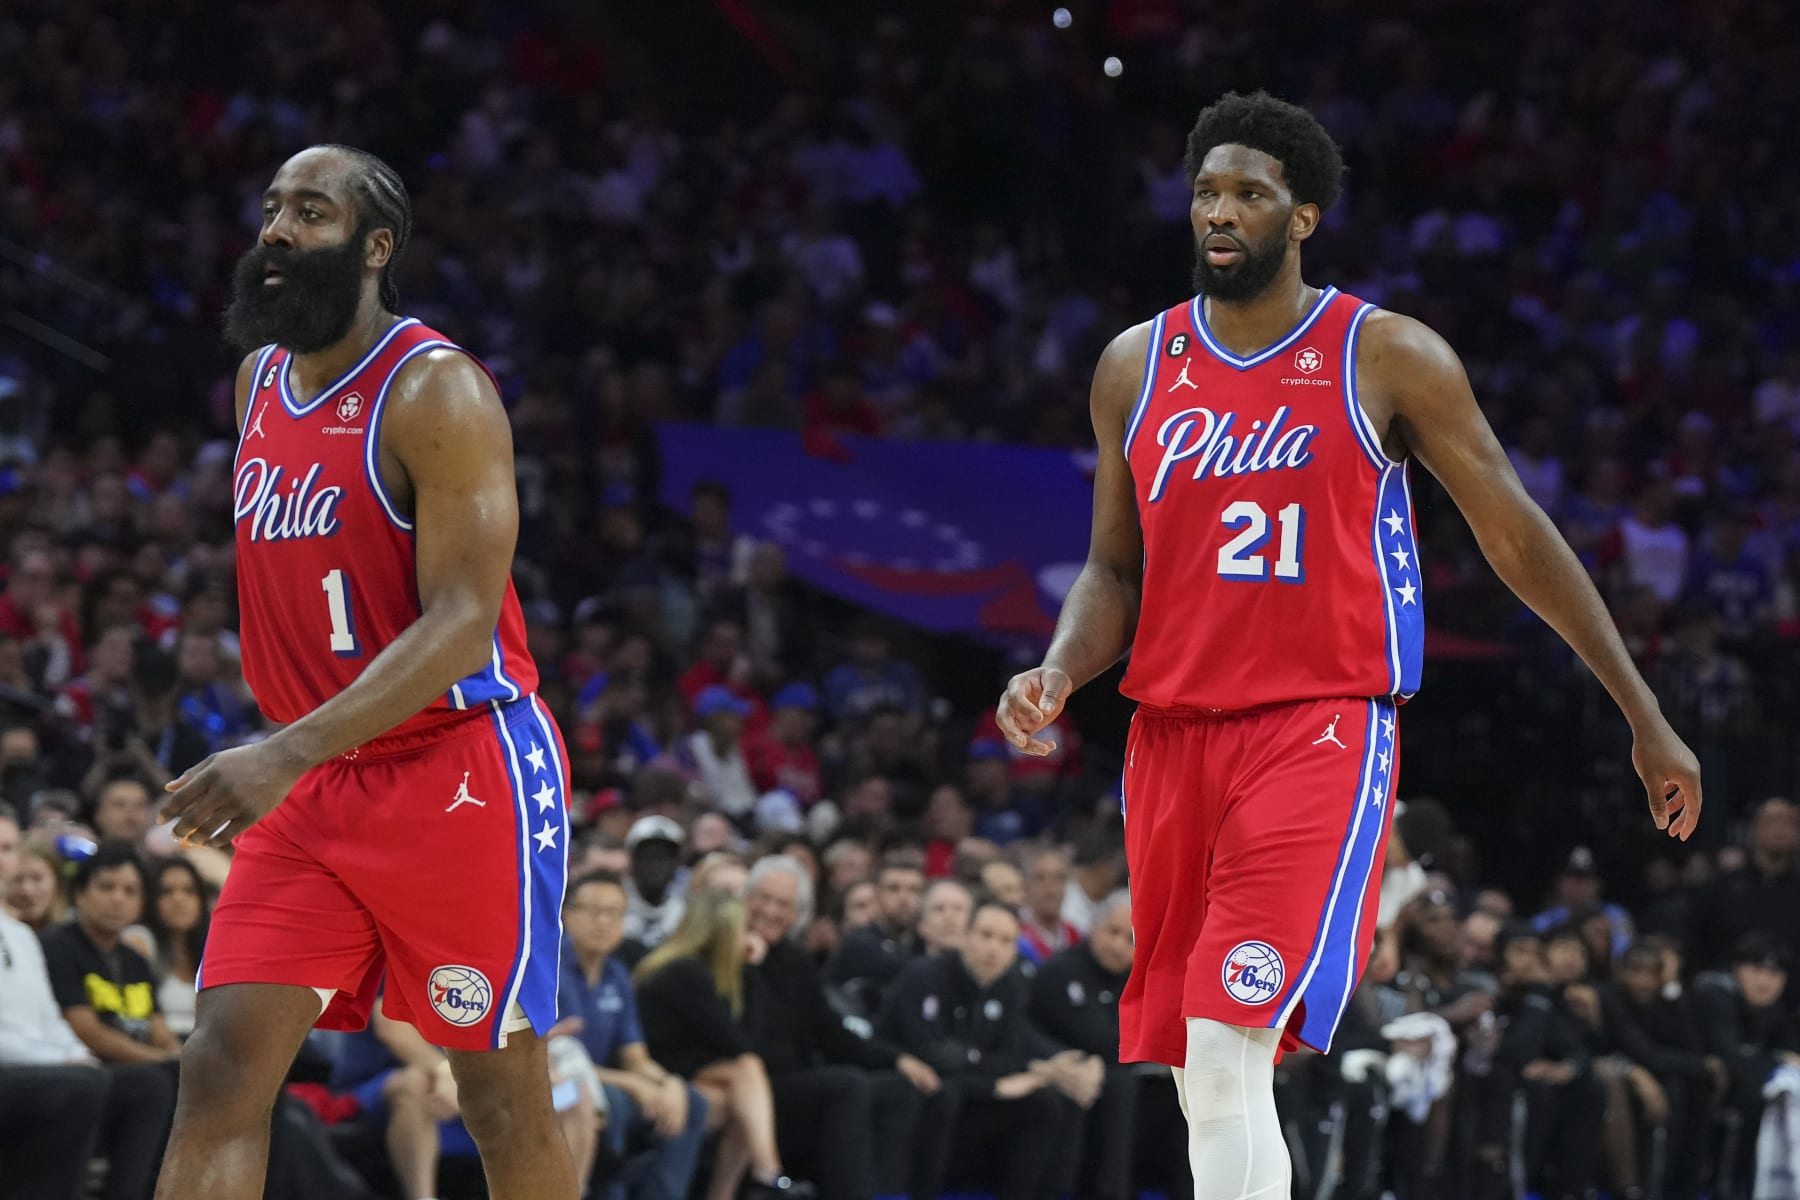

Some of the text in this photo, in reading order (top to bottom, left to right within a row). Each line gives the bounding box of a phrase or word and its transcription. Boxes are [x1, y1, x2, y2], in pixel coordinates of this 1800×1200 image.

[1171, 336, 1185, 355] 6
[263, 365, 278, 388] 6
[1280, 377, 1332, 387] crypto.com
[321, 426, 364, 436] crypto.com
[1148, 406, 1319, 503] Phila
[234, 457, 345, 543] Phila
[1217, 501, 1304, 583] 21
[321, 569, 359, 656] 1
[1228, 960, 1276, 992] 76ers
[434, 981, 484, 1011] 76ers
